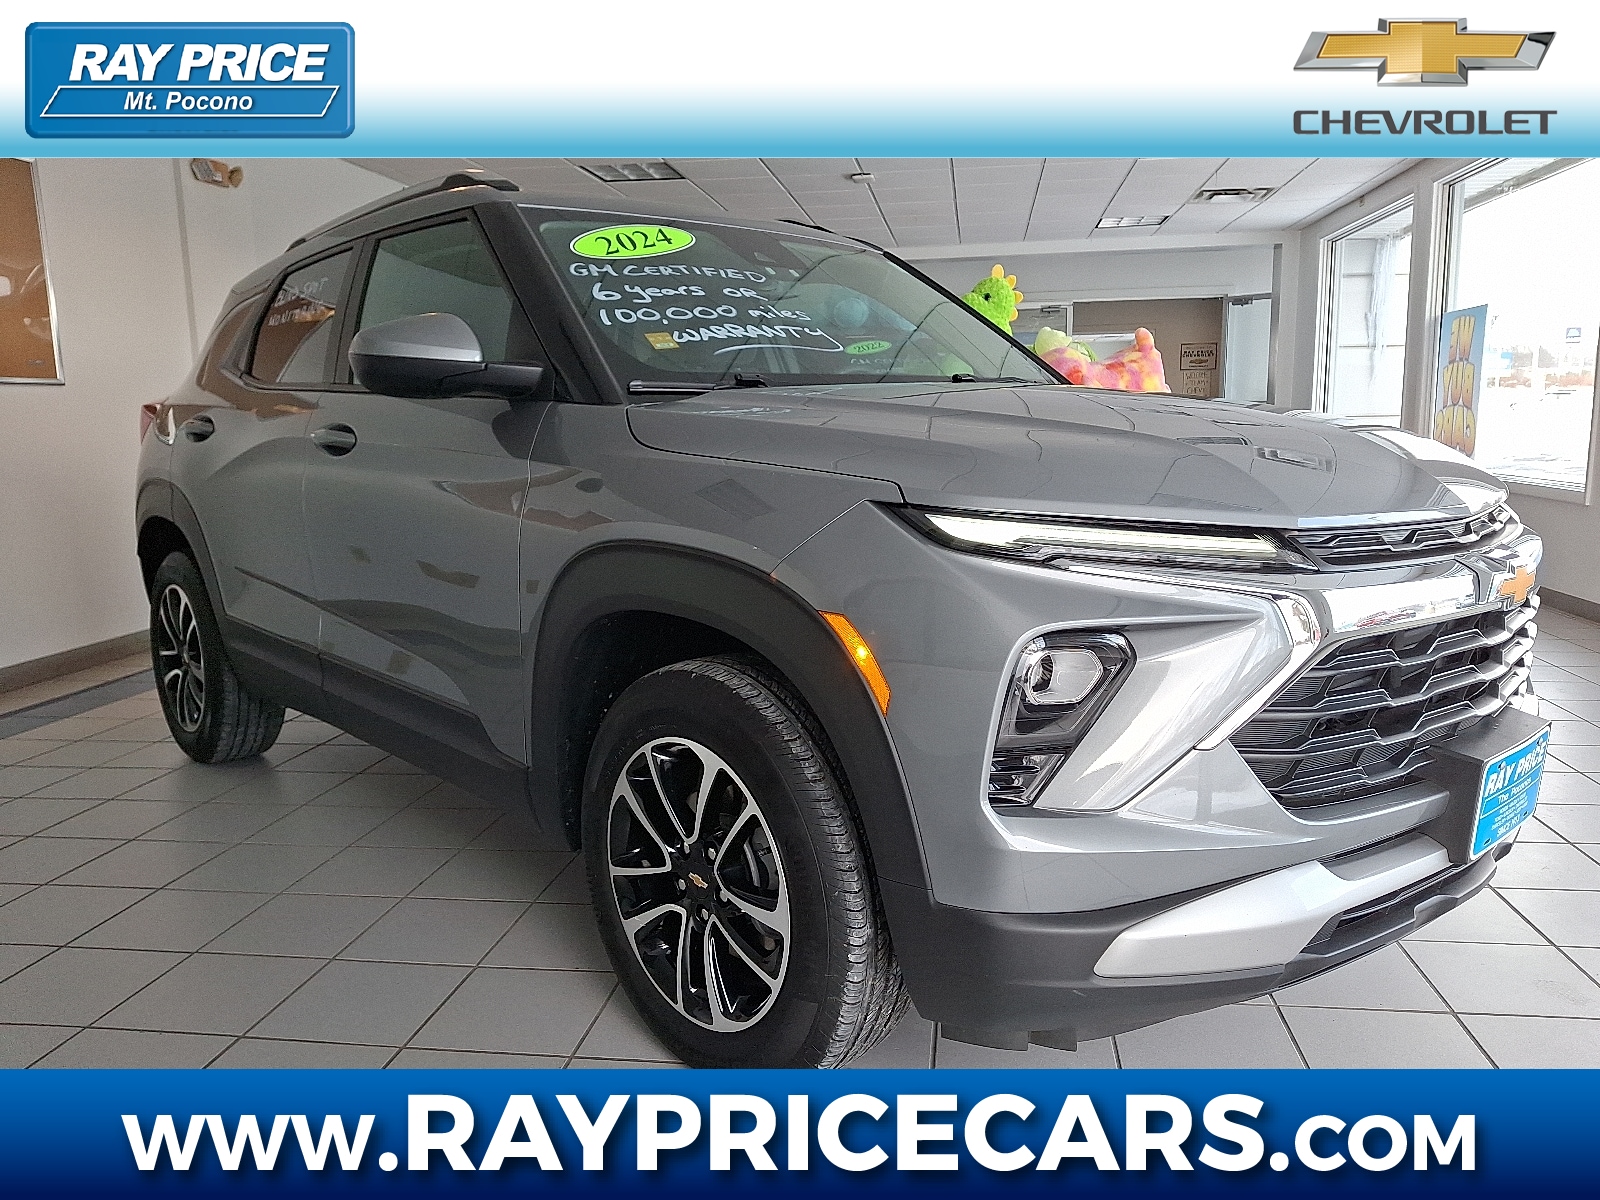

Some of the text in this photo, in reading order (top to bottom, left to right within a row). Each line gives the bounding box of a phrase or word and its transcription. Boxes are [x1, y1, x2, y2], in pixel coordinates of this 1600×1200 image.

[594, 227, 673, 255] 2024
[569, 262, 767, 283] GM CERTIFIED
[591, 281, 622, 301] 6
[624, 283, 706, 304] years
[599, 304, 812, 325] 100,000 miles
[1484, 741, 1548, 797] RAY PRICE
